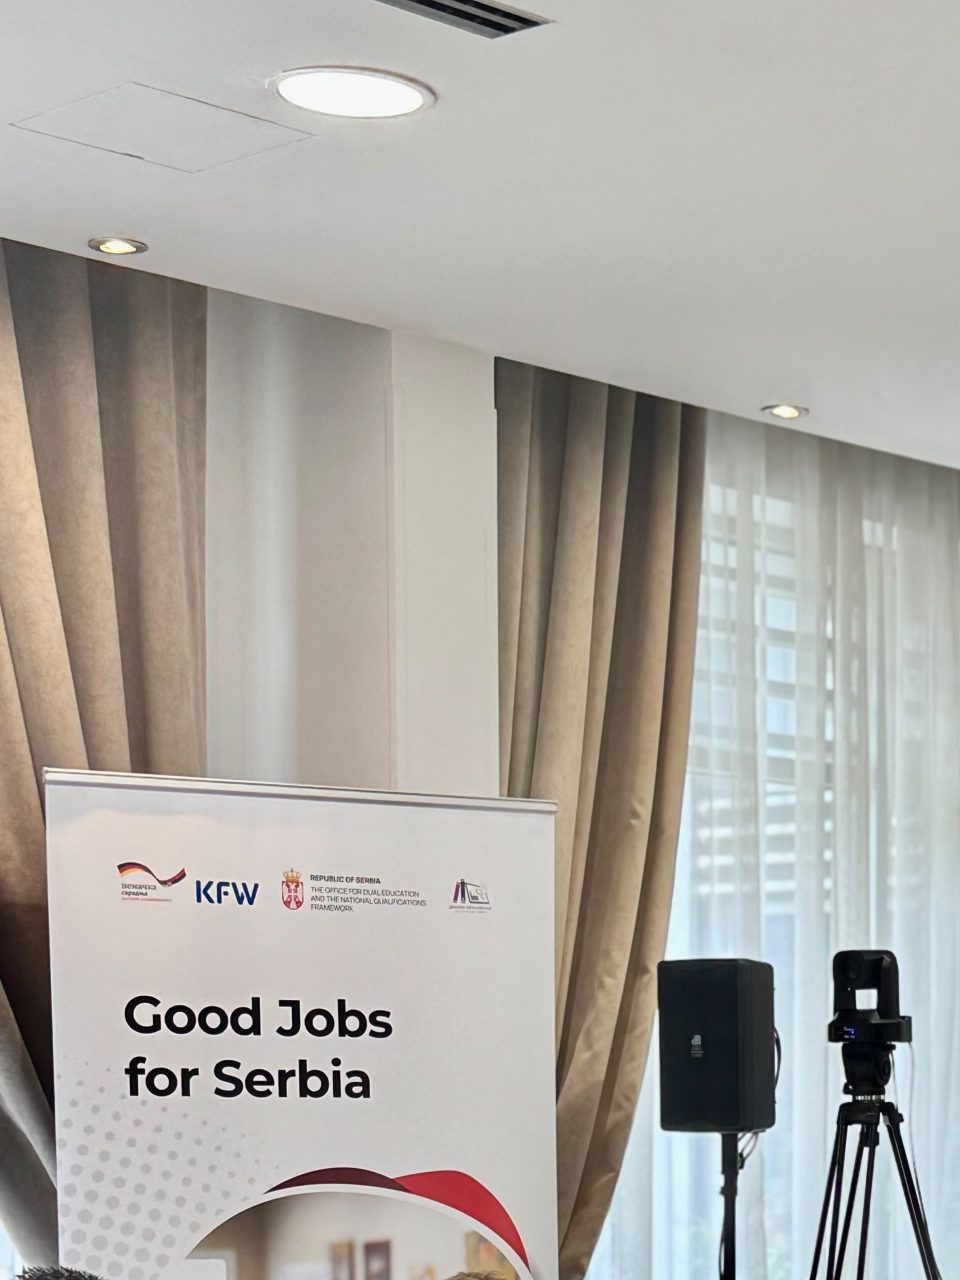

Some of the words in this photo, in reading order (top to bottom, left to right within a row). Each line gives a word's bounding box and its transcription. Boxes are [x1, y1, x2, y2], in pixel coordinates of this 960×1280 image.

[310, 875, 345, 883] REPUBLIC
[355, 877, 381, 885] SERBIA
[195, 880, 259, 906] KFW
[325, 887, 348, 895] OFFICE
[363, 889, 380, 897] DUAL
[381, 890, 420, 898] EDUCATION
[340, 897, 373, 905] NATIONAL
[373, 898, 427, 907] QUALIFICATIONS
[310, 904, 354, 912] FRAMEWORK
[124, 995, 262, 1037] Good
[276, 998, 394, 1039] Jobs
[124, 1055, 200, 1097] for
[213, 1056, 371, 1099] Serbia
